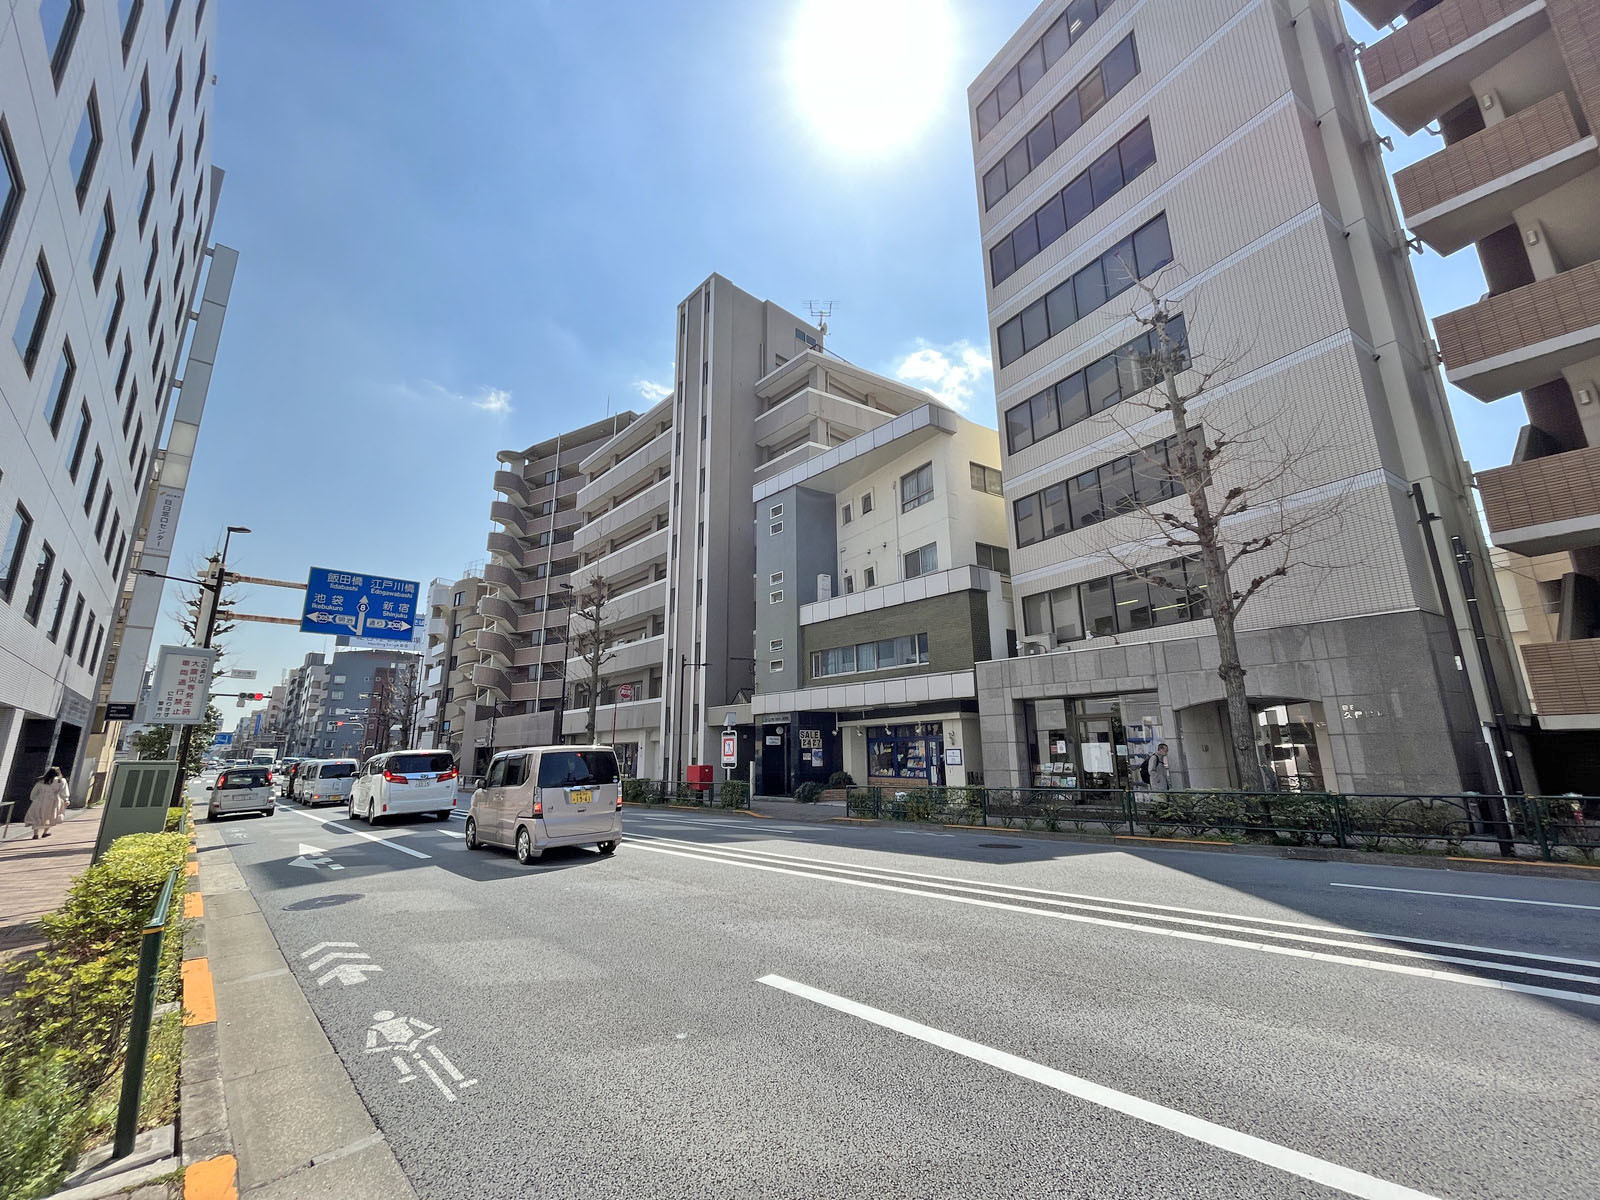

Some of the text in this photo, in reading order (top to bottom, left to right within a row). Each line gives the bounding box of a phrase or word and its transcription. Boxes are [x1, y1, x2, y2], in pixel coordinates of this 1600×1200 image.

[327, 572, 363, 587] 飯田橋
[370, 579, 415, 593] 江戸川橋
[313, 593, 344, 606] 池袋
[311, 603, 344, 612] Ikebukuro
[382, 601, 410, 613] 新宿
[382, 611, 408, 619] Shinjuku
[800, 730, 819, 739] SALE
